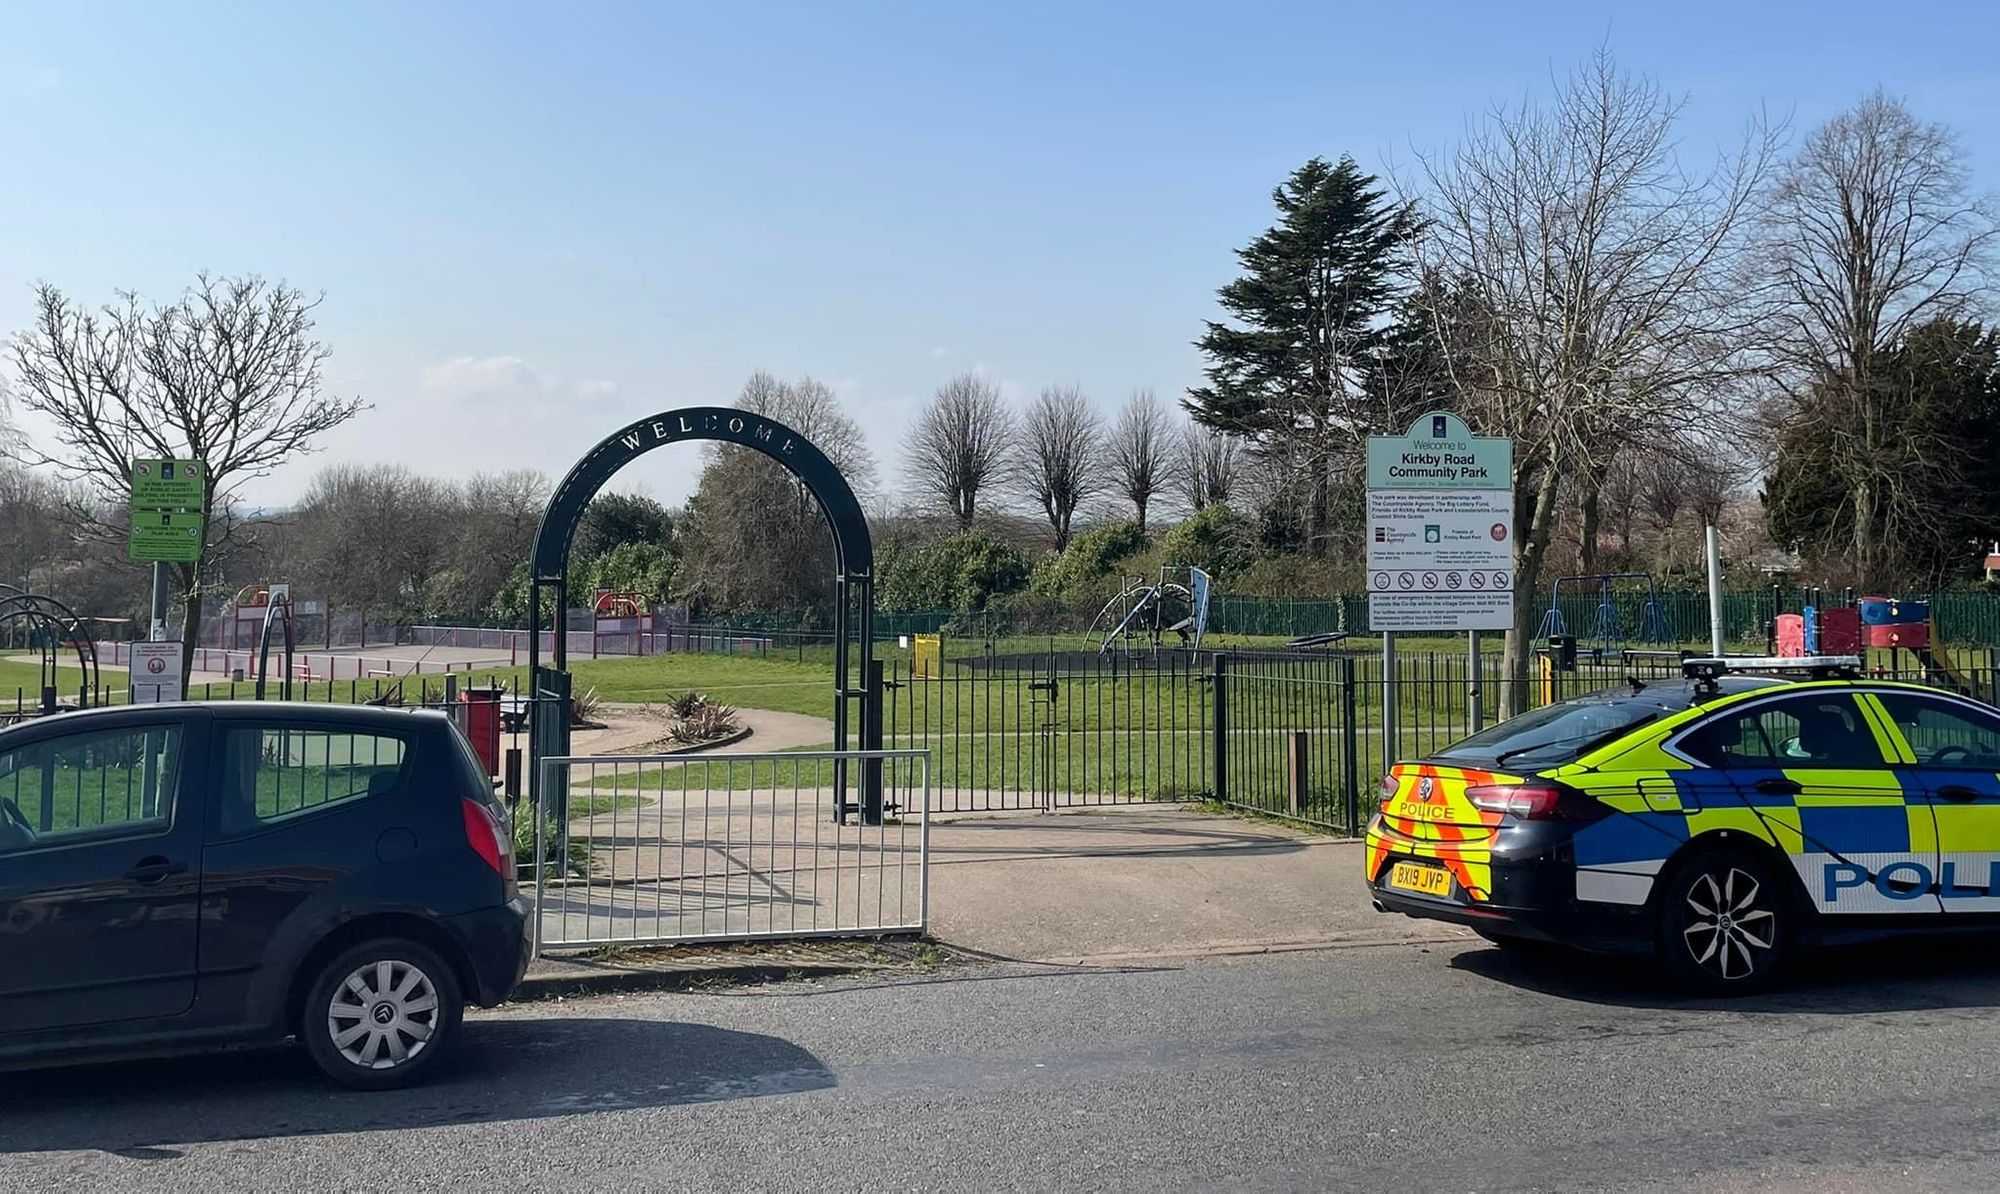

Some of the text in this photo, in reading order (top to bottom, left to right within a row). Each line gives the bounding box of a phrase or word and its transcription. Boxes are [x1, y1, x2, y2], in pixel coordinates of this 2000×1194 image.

[621, 415, 795, 455] WELCOME
[1413, 440, 1466, 450] Welcome to
[1402, 454, 1475, 467] Kirkby Road
[1389, 466, 1488, 480] Community Park
[1401, 803, 1454, 819] POLICE
[1397, 866, 1443, 889] BX19 JVP
